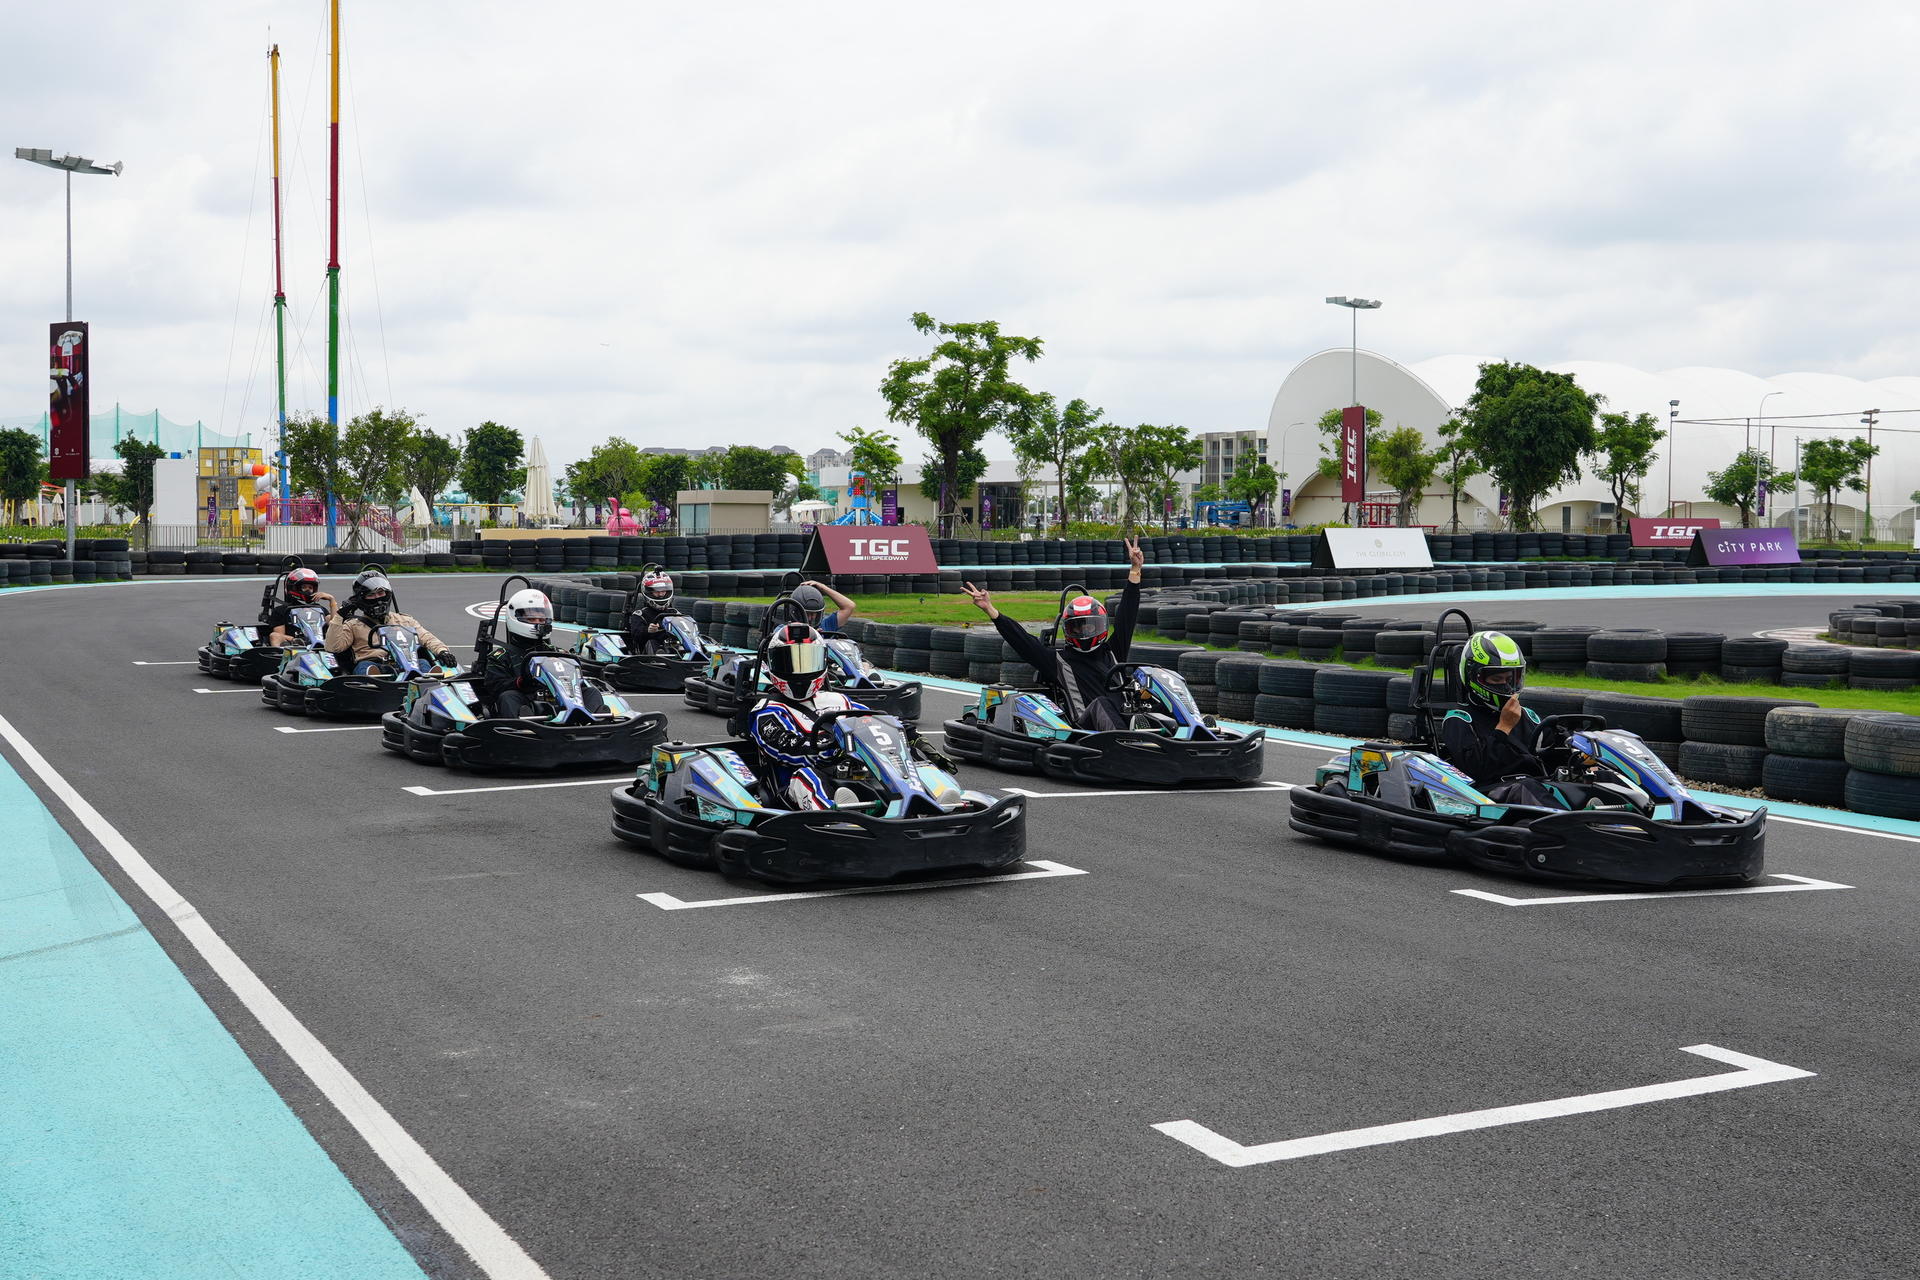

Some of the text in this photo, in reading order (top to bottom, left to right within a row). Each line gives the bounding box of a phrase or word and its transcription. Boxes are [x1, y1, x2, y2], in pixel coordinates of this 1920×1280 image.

[1653, 526, 1703, 536] TGC
[849, 539, 910, 555] TGC
[1751, 541, 1783, 552] PARK
[306, 612, 312, 620] 7
[397, 631, 407, 642] 4
[553, 662, 565, 672] 8
[868, 725, 893, 745] 5
[1612, 737, 1643, 755] 3
